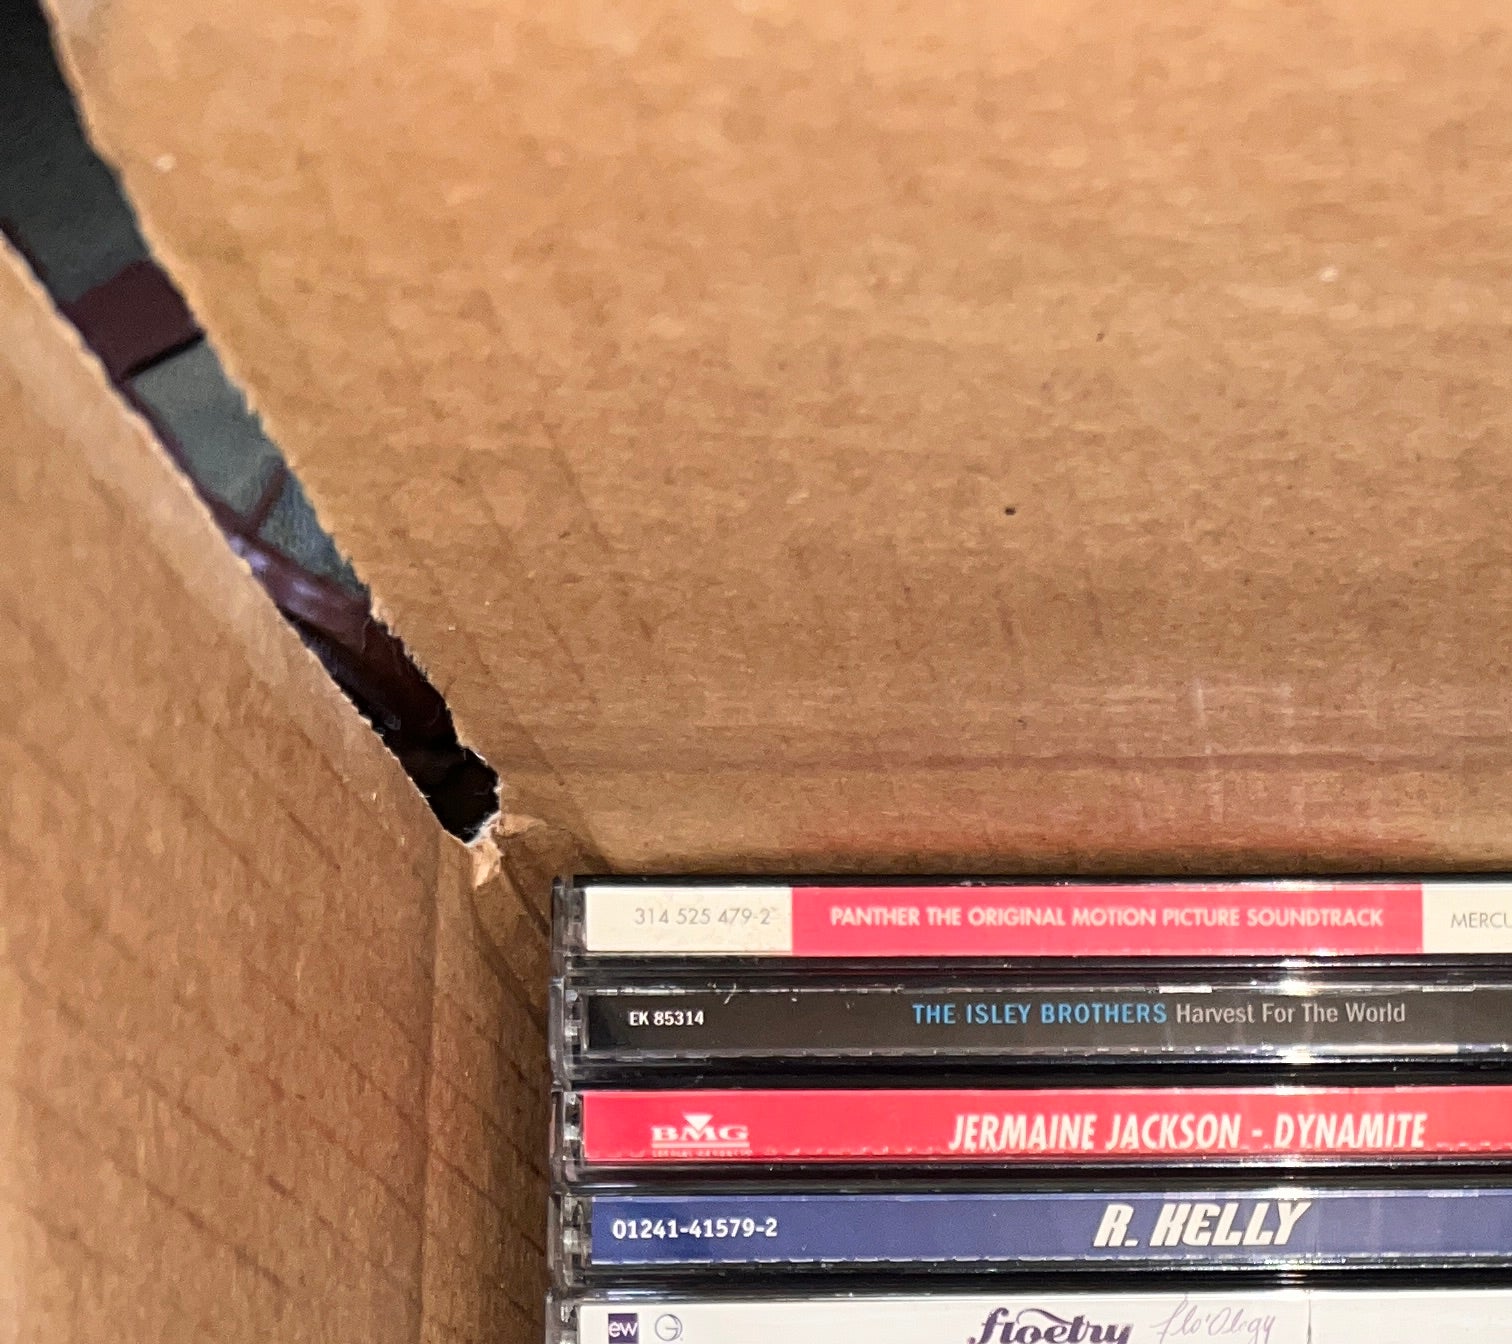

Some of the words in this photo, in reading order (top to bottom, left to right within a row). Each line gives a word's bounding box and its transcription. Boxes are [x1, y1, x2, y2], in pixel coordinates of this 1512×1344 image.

[717, 907, 771, 925] 479-2
[831, 907, 920, 926] PANTHER
[969, 907, 1065, 926] ORIGINAL
[1072, 907, 1156, 926] MOTION
[1163, 907, 1240, 927] PICTURE
[1247, 907, 1383, 927] SOUNDTRACK
[653, 1010, 704, 1026] 85314
[967, 1005, 1030, 1025] ISLEY
[1041, 1004, 1167, 1025] BROTHERS
[1177, 1004, 1254, 1024] Harvest
[1345, 1003, 1405, 1023] World
[651, 1124, 749, 1142] BMG
[949, 1115, 1096, 1151] JERMAINE
[1105, 1114, 1241, 1150] JACKSON
[1274, 1113, 1427, 1149] DYNAMITE
[613, 1219, 778, 1240] 01241-41579-2
[1150, 1202, 1312, 1247] KELLY
